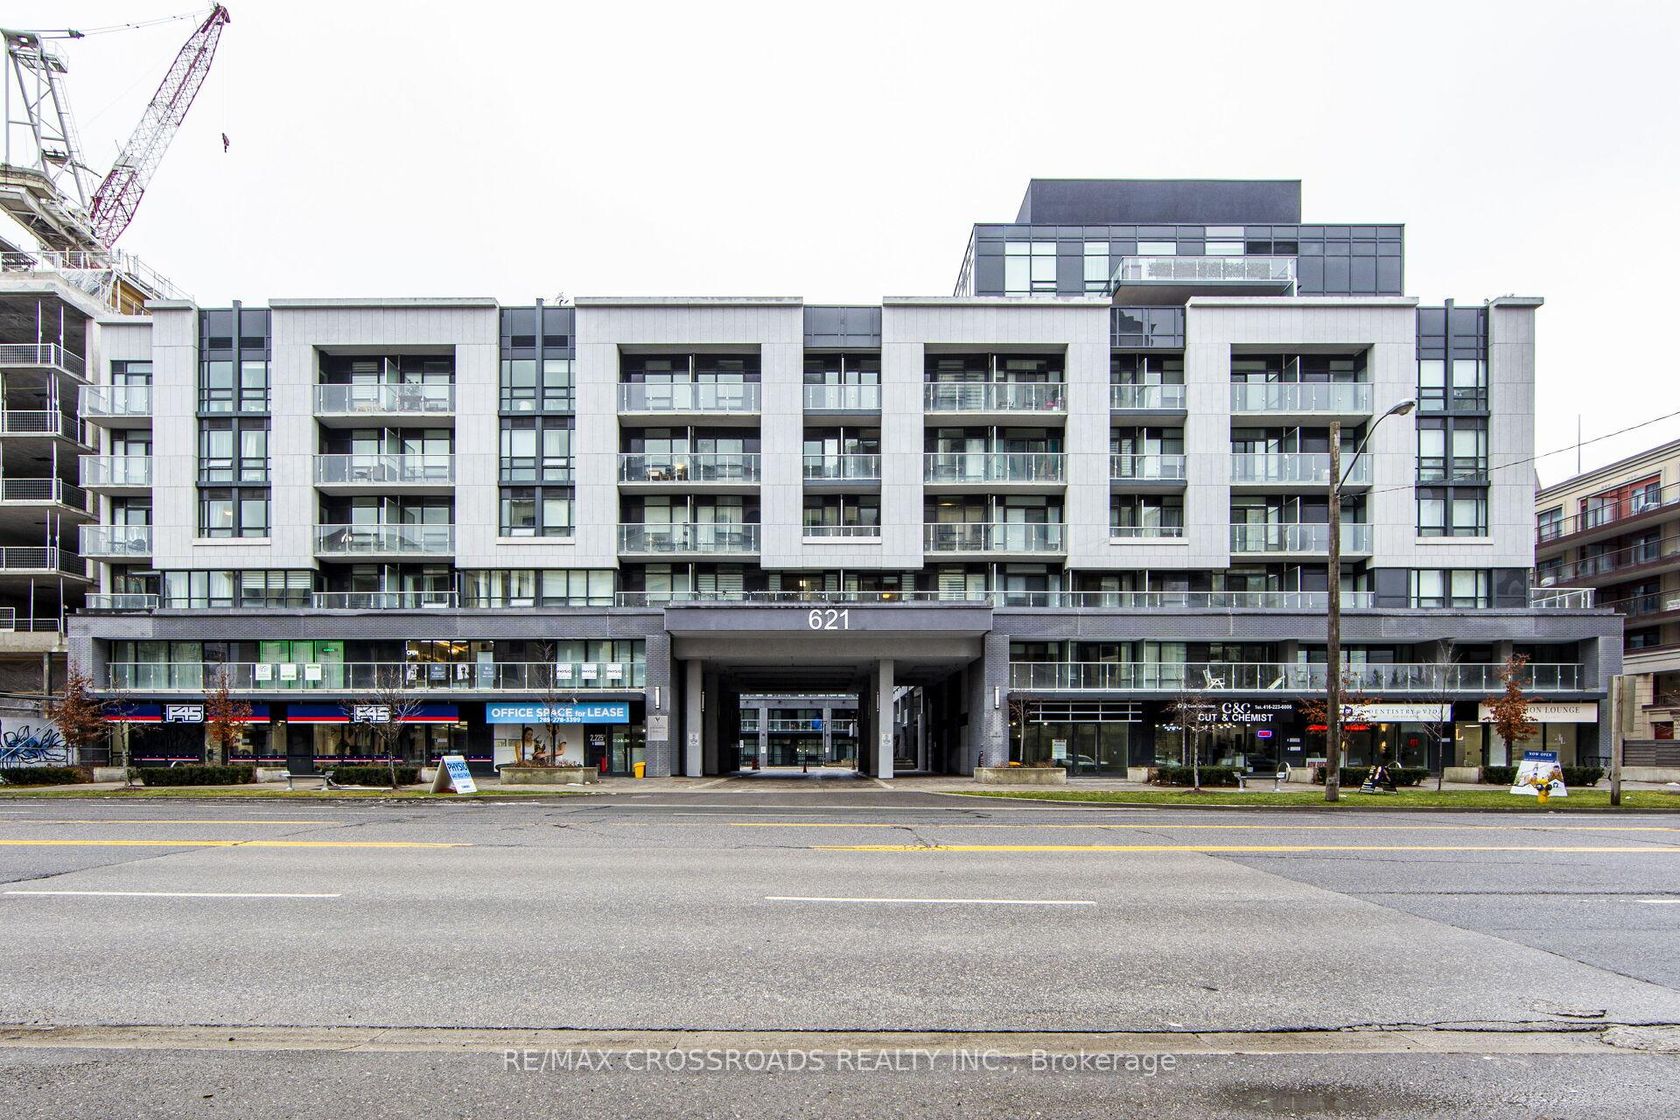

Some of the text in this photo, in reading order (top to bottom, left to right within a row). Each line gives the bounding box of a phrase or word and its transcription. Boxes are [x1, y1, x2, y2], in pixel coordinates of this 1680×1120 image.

[808, 609, 849, 630] 621
[167, 705, 203, 721] F45
[355, 705, 390, 721] F45
[491, 708, 533, 718] OFFICE
[536, 708, 573, 718] SPACE
[587, 707, 624, 717] LEASE
[1221, 702, 1251, 714] C&C
[1544, 706, 1581, 714] LOUNGE
[1198, 713, 1274, 722] CUT & CHEMIST
